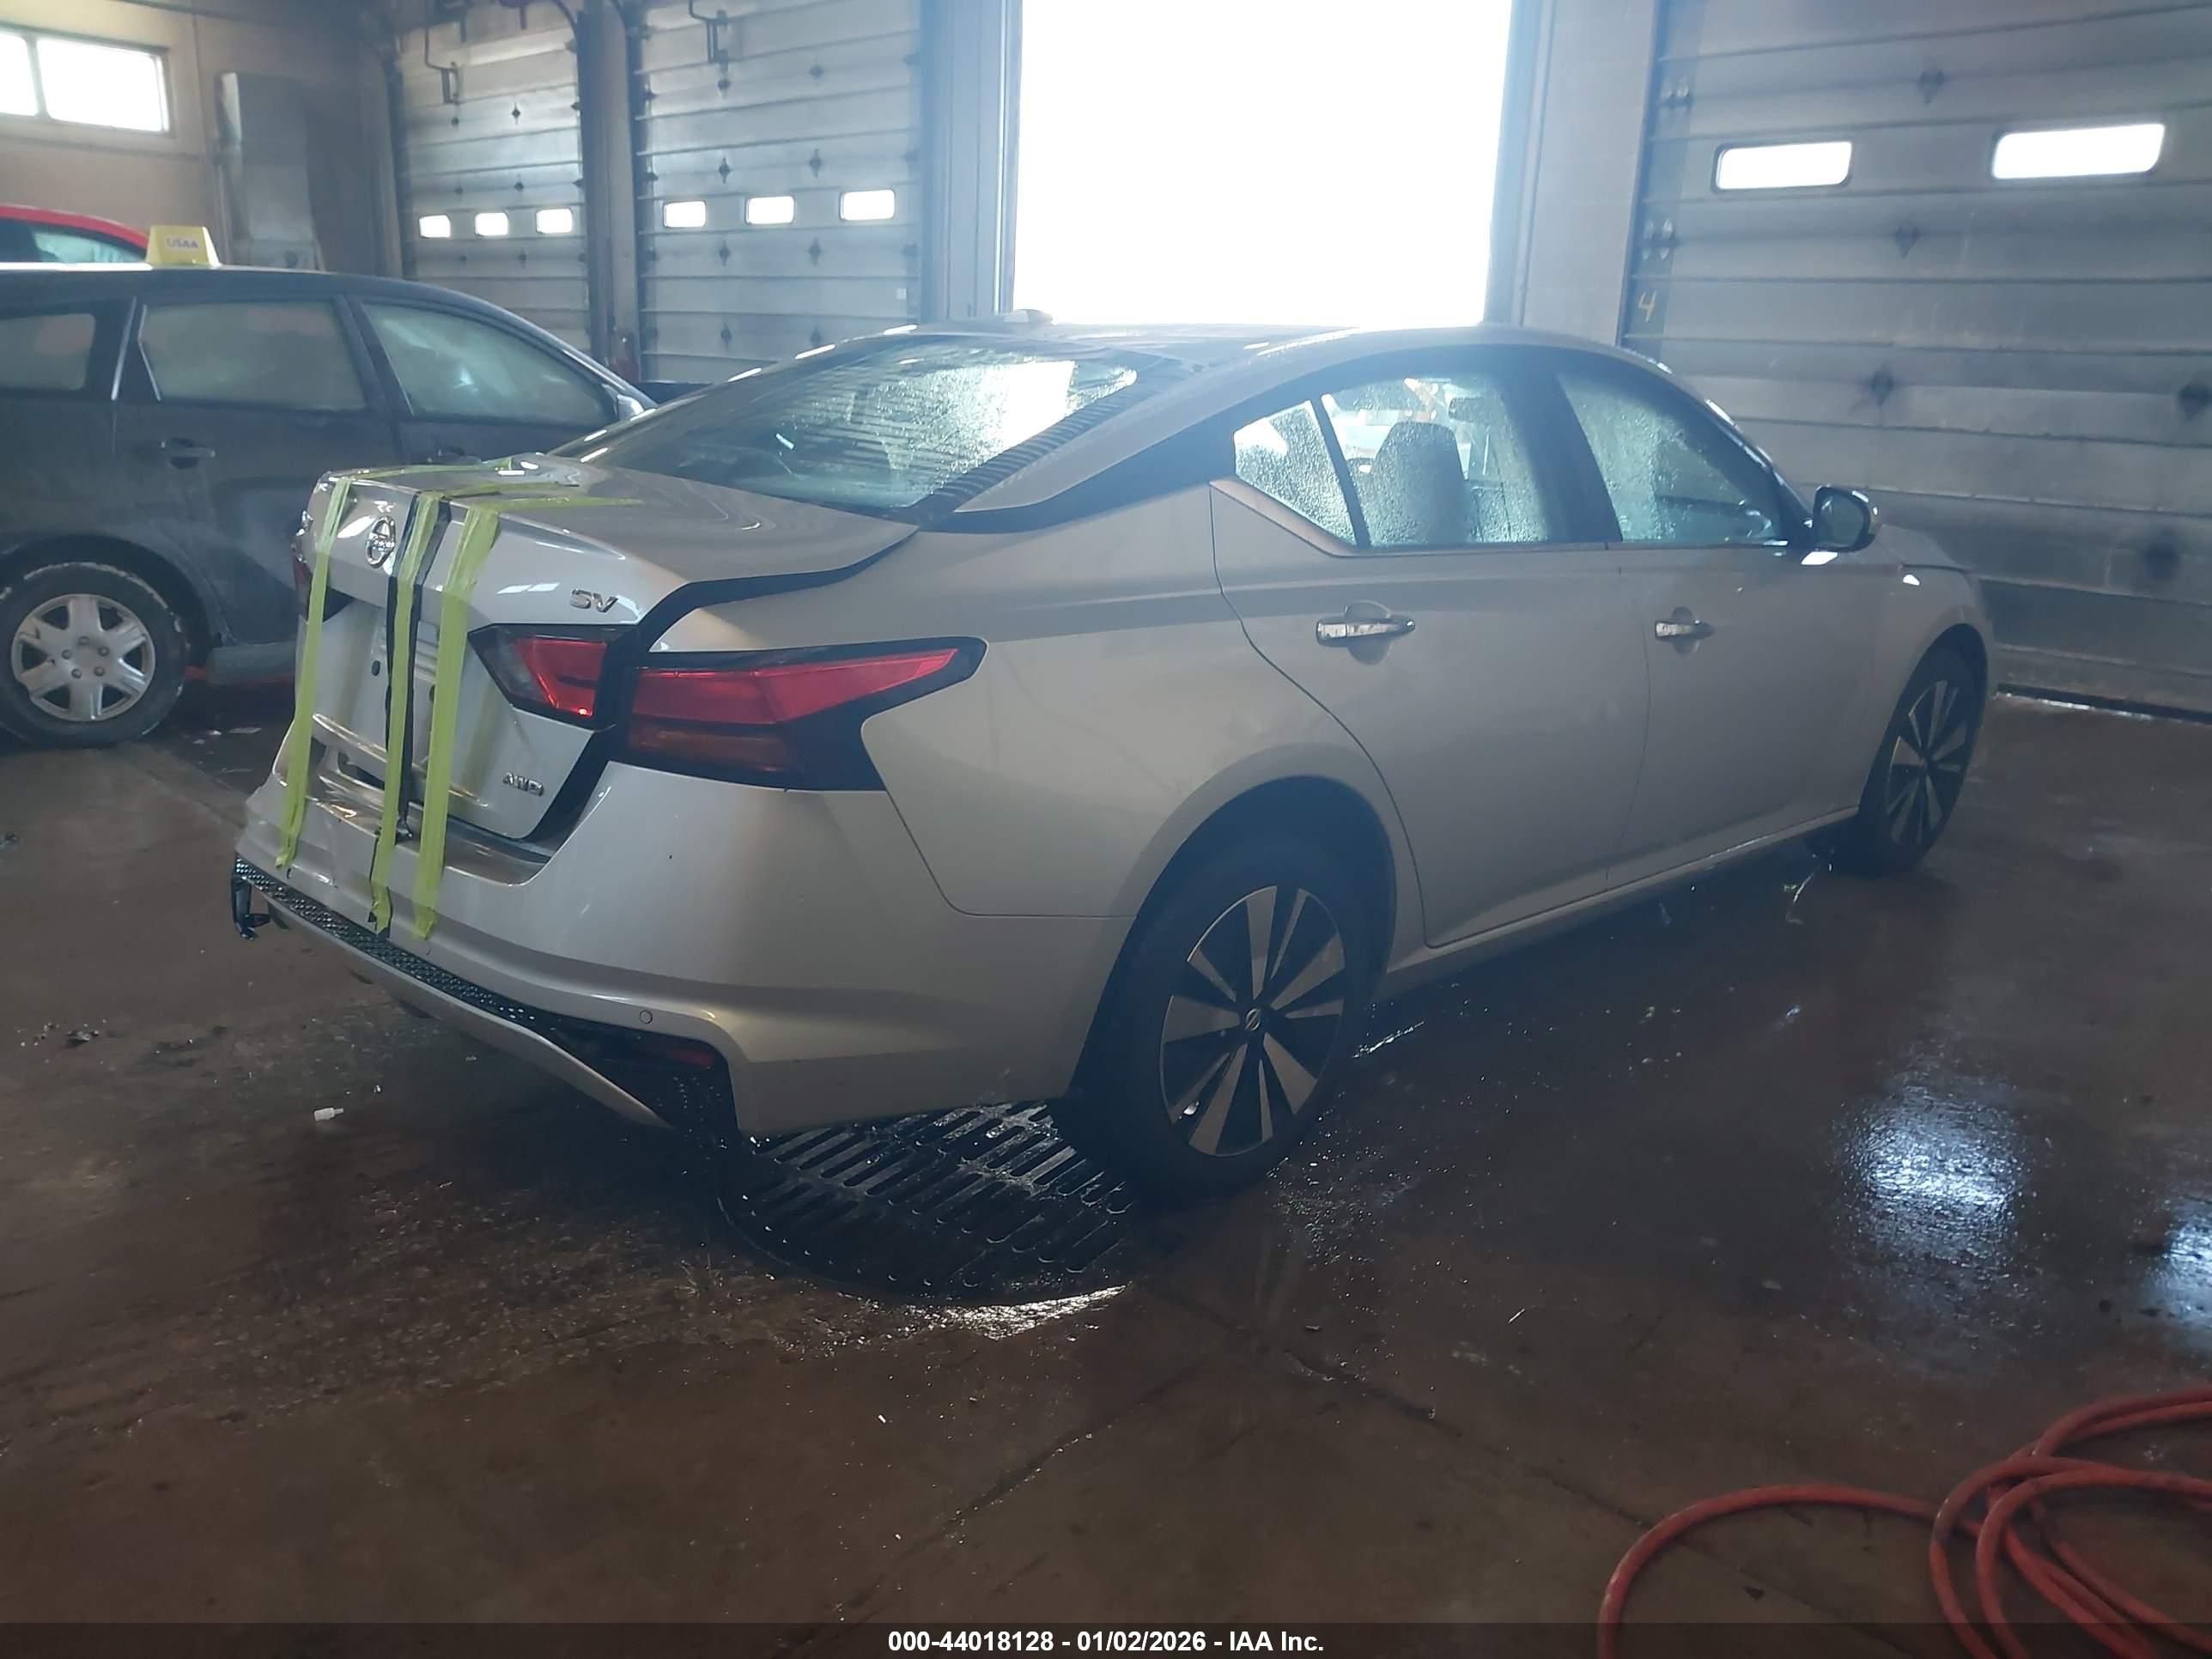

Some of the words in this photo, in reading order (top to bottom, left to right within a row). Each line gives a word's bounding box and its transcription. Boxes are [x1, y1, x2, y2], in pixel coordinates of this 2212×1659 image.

[1638, 289, 1656, 323] 4
[569, 589, 618, 613] SV
[502, 772, 544, 797] AWD
